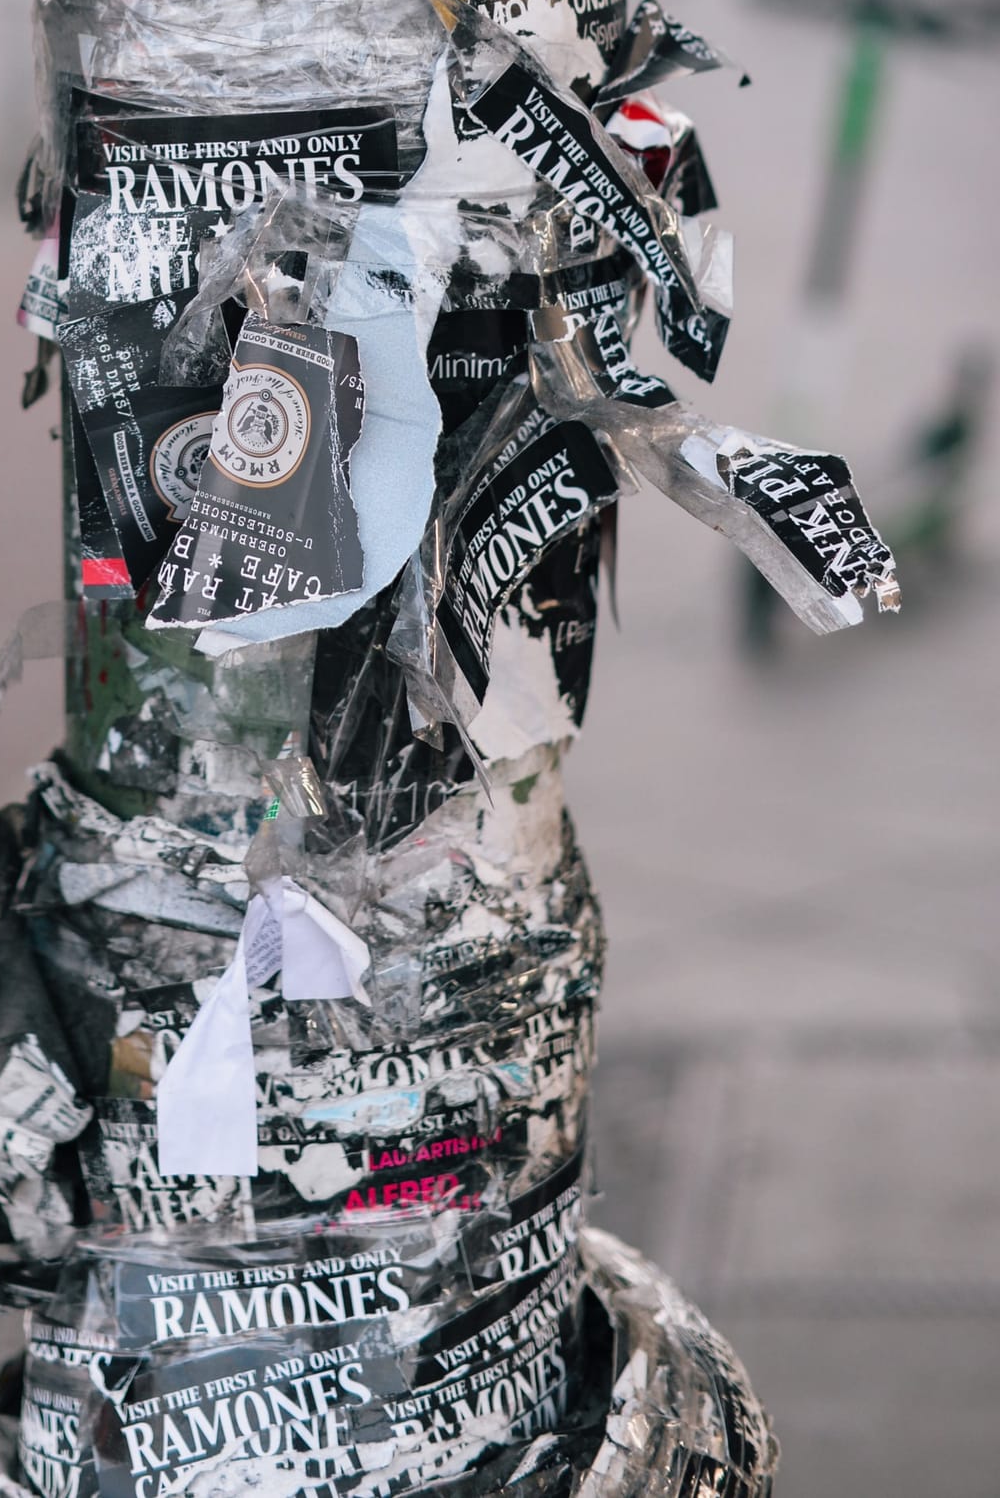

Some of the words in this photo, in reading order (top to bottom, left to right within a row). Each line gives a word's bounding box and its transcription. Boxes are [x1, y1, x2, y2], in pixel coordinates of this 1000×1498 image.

[102, 142, 148, 164] VISIT
[151, 143, 190, 161] THE
[194, 139, 251, 159] FIRST
[258, 136, 301, 157] AND
[306, 132, 364, 153] ONLY
[104, 153, 365, 216] RAMONES
[523, 86, 564, 140] VISIT
[557, 127, 591, 168] THE
[582, 161, 625, 208] FIRST
[616, 204, 653, 240] AND
[643, 238, 680, 289] ONLY
[557, 290, 588, 313] VISIT
[588, 283, 610, 305] THE
[95, 334, 114, 363] 365
[242, 331, 267, 345] GOOD
[269, 339, 277, 347] A
[276, 341, 294, 353] FOR
[296, 347, 316, 362] BEER
[217, 443, 281, 478] RMCM
[122, 471, 134, 487] FOR
[132, 499, 146, 523] GOOD
[468, 512, 499, 558] FIRST
[498, 484, 527, 521] AND
[526, 447, 571, 490] ONLY
[240, 555, 322, 598] CAFE
[462, 467, 590, 662] RAMONES
[489, 1222, 530, 1252] VISIT
[147, 1273, 196, 1295] VISIT
[200, 1270, 239, 1289] THE
[242, 1264, 296, 1286] FIRST
[301, 1257, 347, 1280] AND
[350, 1247, 403, 1271] ONLY
[149, 1265, 411, 1343] RAMONES
[434, 1334, 480, 1372] VISIT
[479, 1313, 513, 1347] THE
[112, 1398, 161, 1425] VISIT
[163, 1386, 202, 1412] THE
[203, 1368, 258, 1400] FIRST
[263, 1357, 306, 1384] AND
[309, 1342, 362, 1372] ONLY
[383, 1393, 434, 1423] VISIT
[435, 1379, 468, 1405] THE
[469, 1359, 509, 1392] FIRST
[511, 1345, 536, 1370] AND
[120, 1361, 373, 1477] RAMONES
